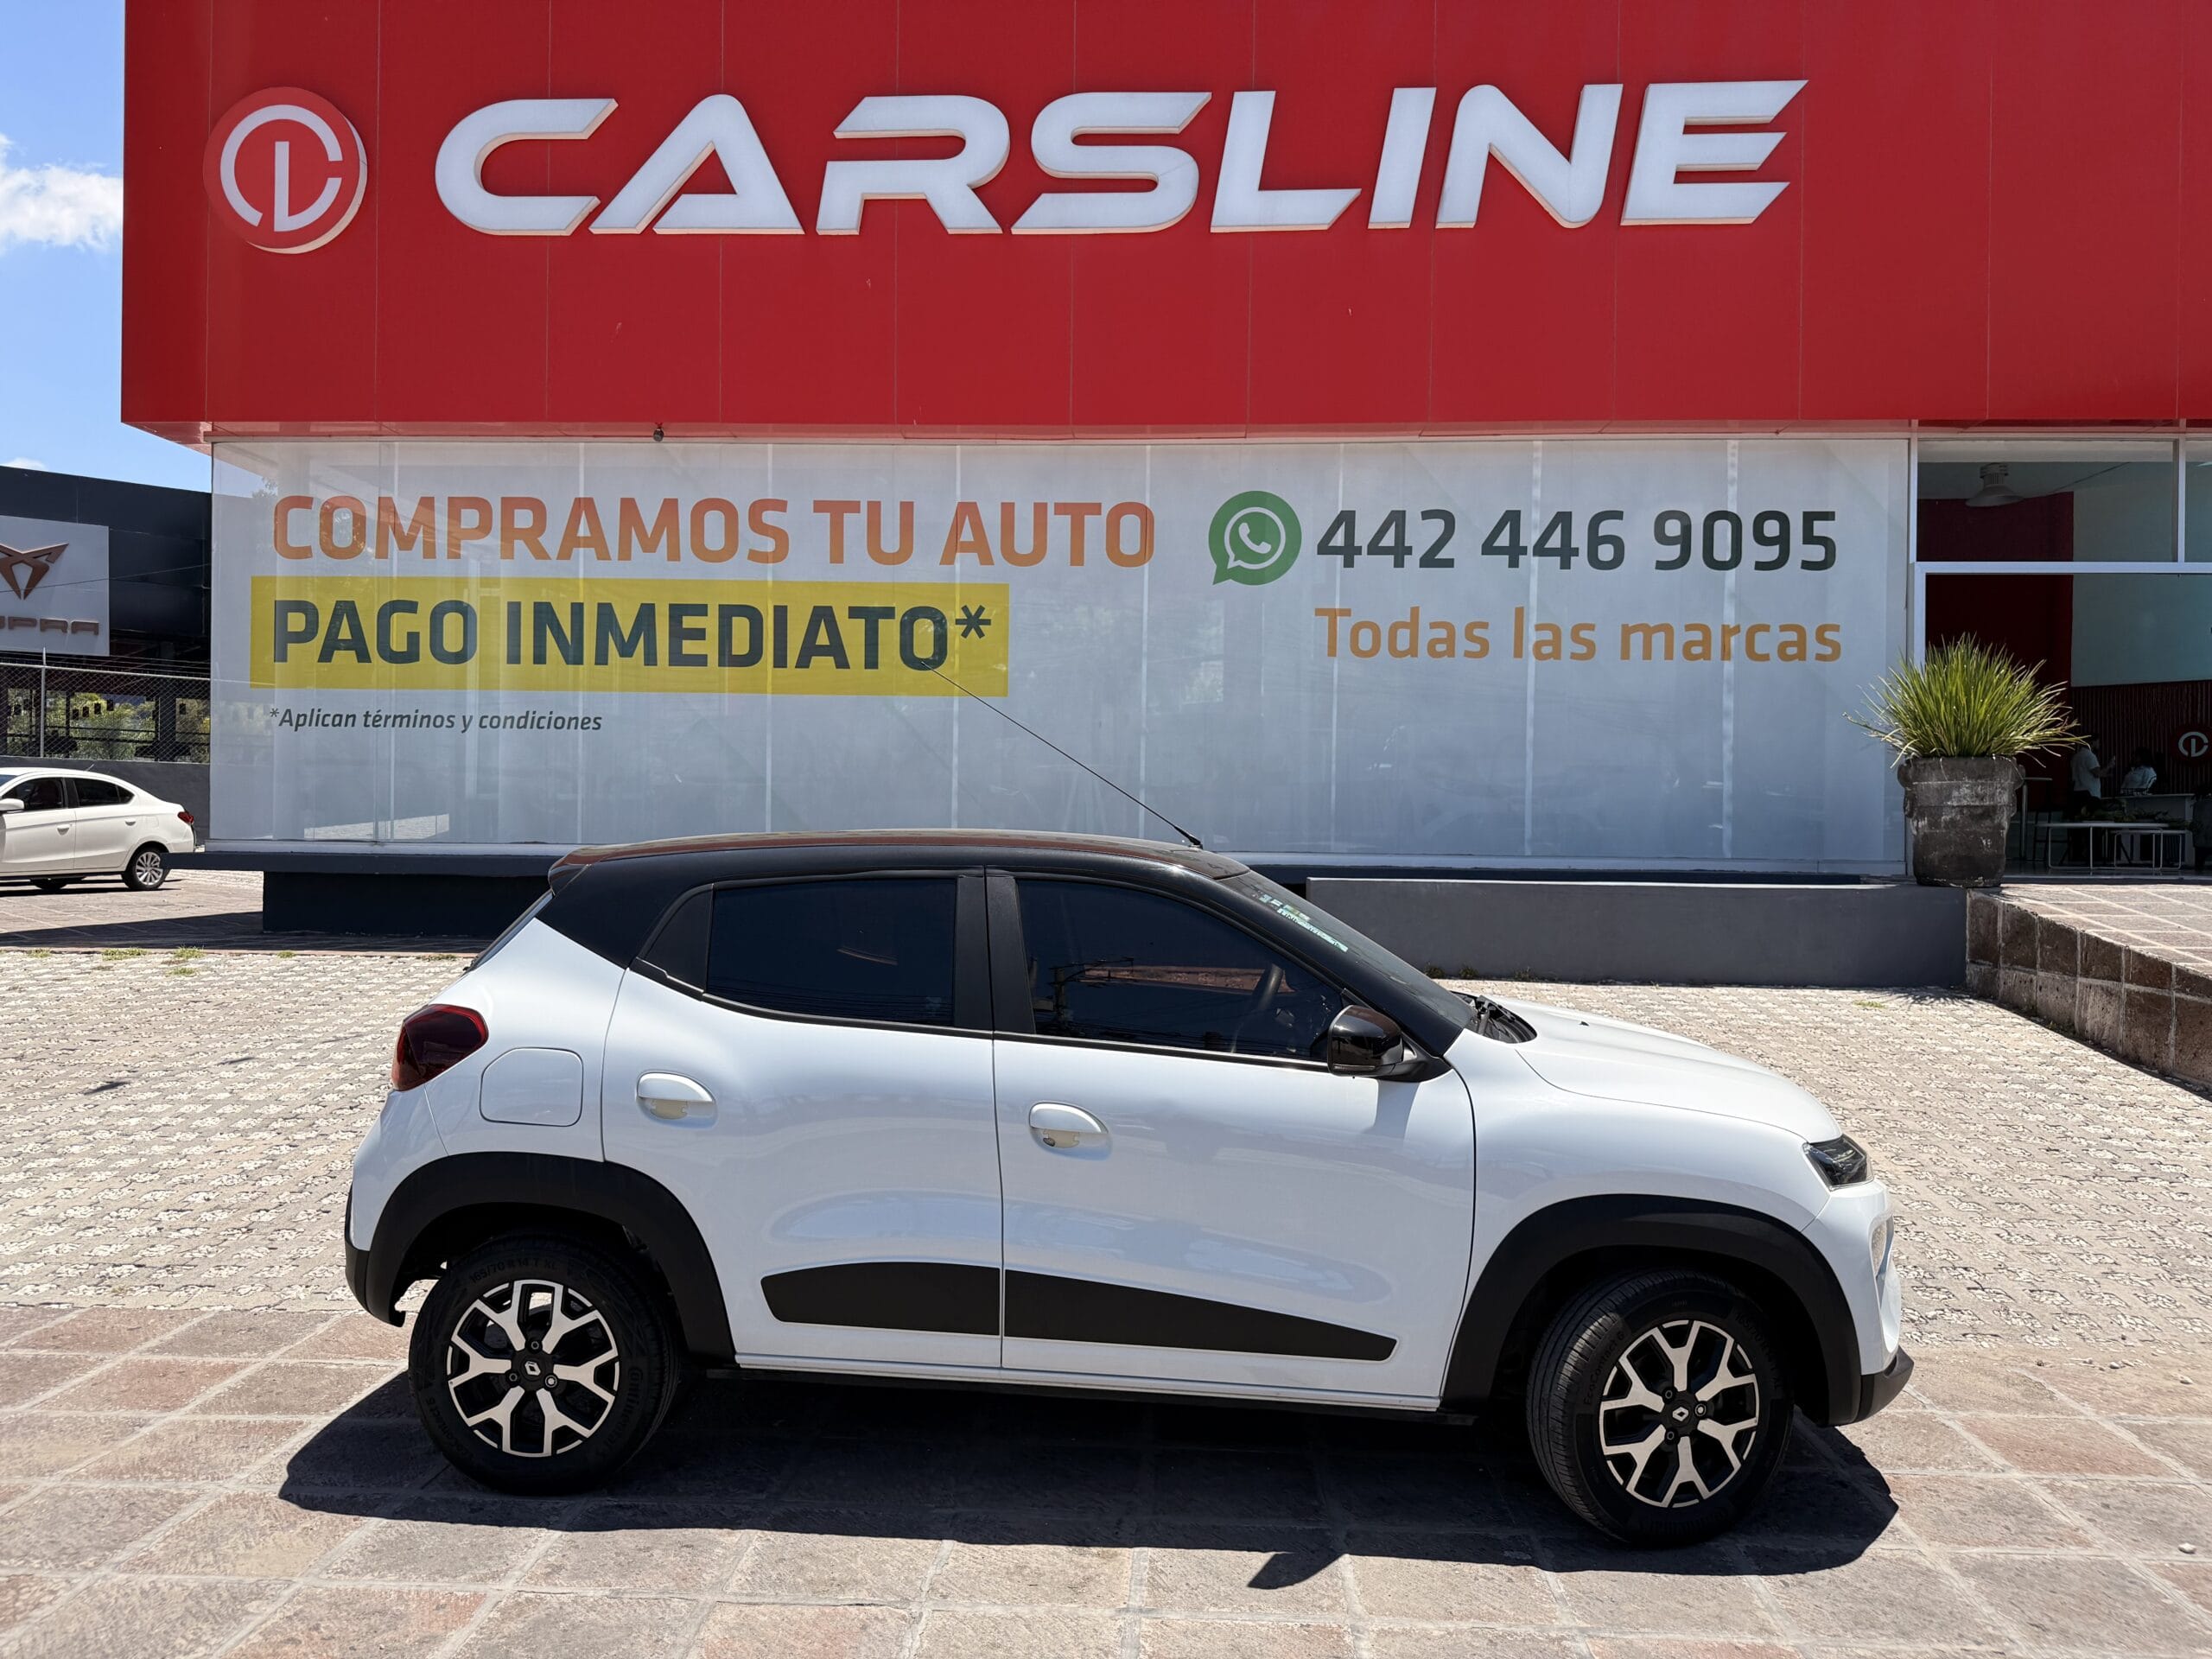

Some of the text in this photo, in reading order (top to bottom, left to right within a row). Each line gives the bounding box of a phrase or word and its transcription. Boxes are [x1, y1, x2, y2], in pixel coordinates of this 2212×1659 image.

[435, 79, 1808, 237] CARSLINE
[273, 495, 1155, 568] COMPRAMOS TU AUTO
[1317, 508, 1837, 571] 442 446 9095
[273, 599, 478, 664] PAGO
[1314, 606, 1841, 662] Todas las marcas
[362, 709, 456, 729] términos
[461, 716, 474, 734] y
[478, 710, 603, 731] condiciones
